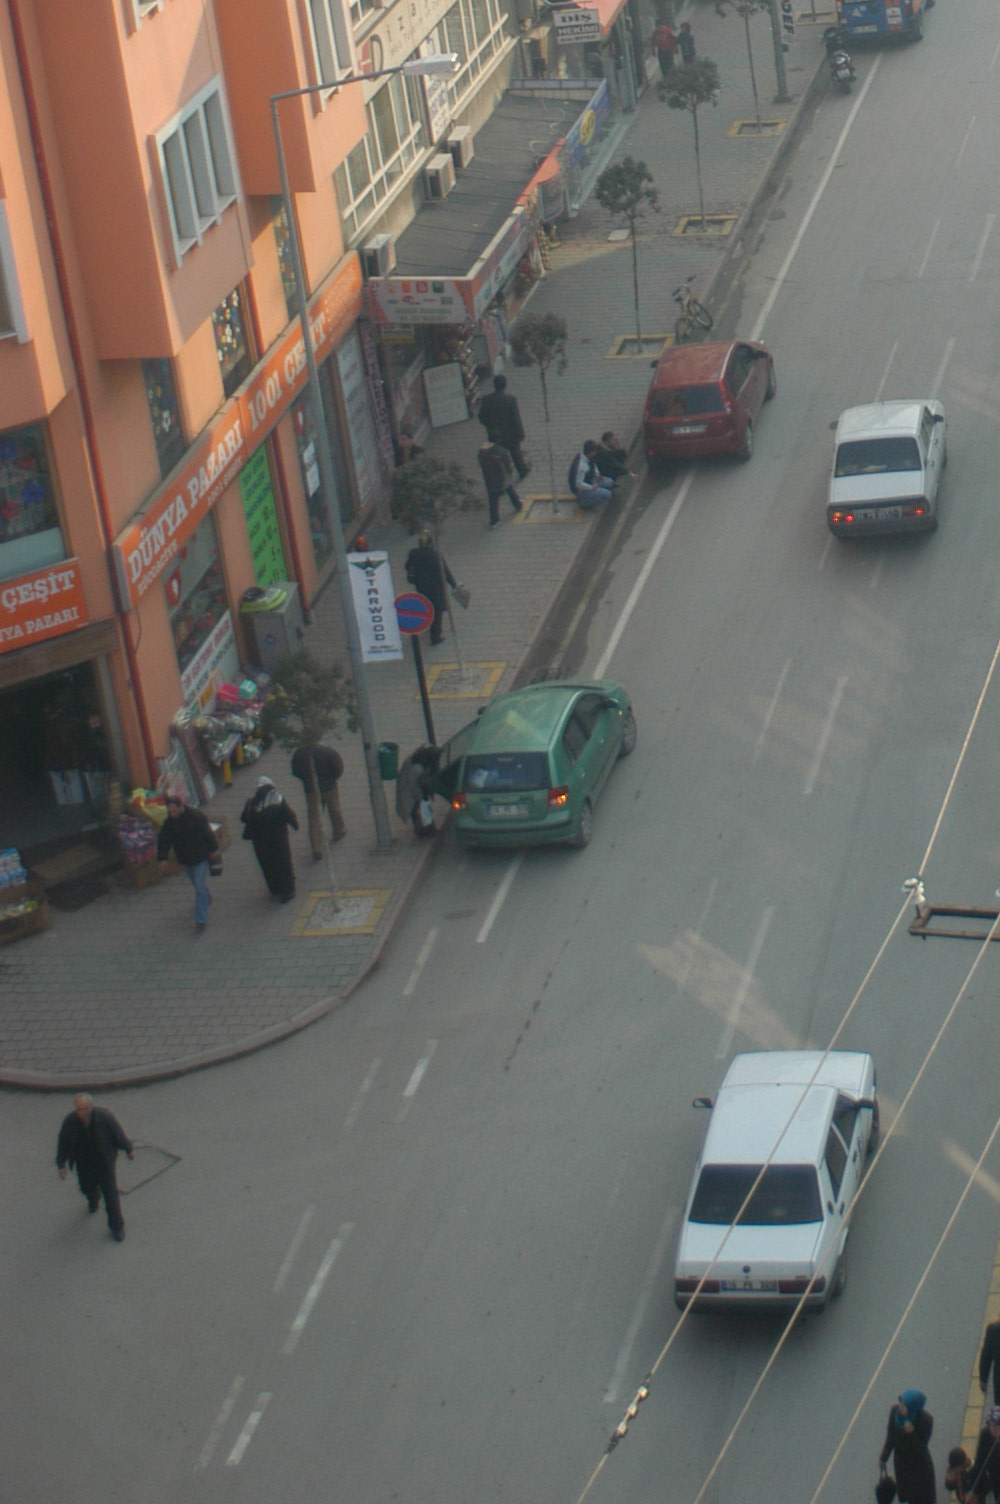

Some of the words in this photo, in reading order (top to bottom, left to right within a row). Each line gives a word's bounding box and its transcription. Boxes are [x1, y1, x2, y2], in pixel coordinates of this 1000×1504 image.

[128, 500, 190, 584] DÜNYA
[188, 420, 245, 503] PAZARI
[1, 570, 75, 613] ÇEŞİT
[365, 569, 385, 641] STARWOOD
[25, 606, 80, 635] PAZARI
